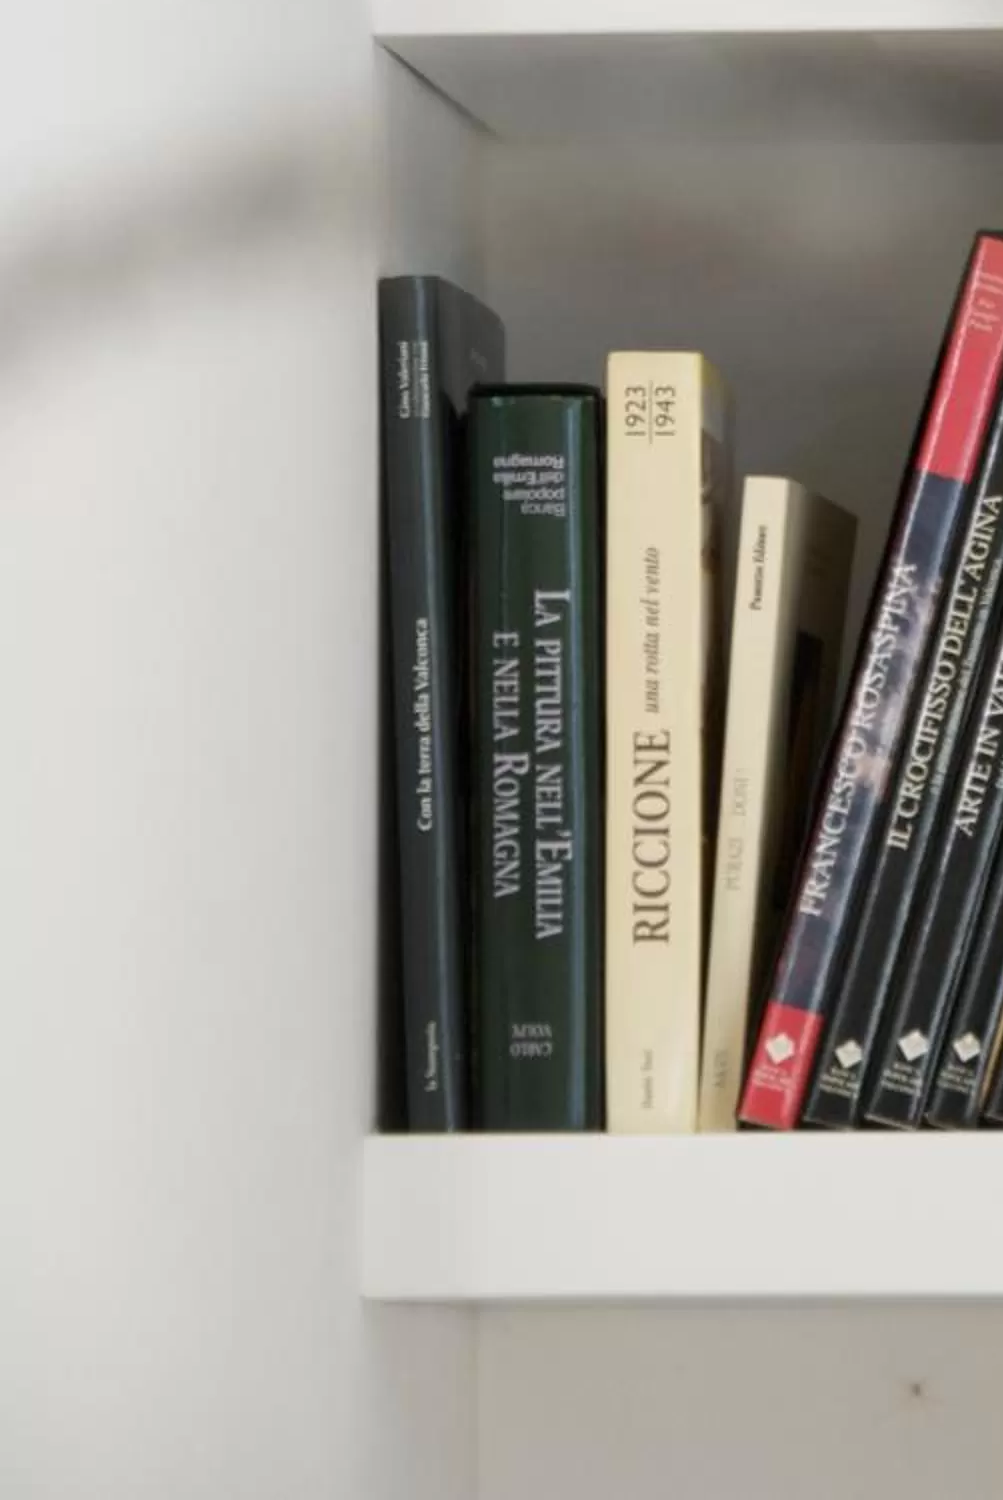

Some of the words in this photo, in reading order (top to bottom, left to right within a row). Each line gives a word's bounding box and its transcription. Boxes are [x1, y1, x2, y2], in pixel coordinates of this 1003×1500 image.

[625, 386, 647, 437] 1923
[655, 386, 676, 437] 1943
[521, 501, 565, 517] Banca
[642, 547, 660, 593] vento
[946, 494, 1003, 658] DELL'AGINA
[533, 590, 571, 627] LA
[639, 597, 660, 627] nel
[411, 618, 431, 689] Valconca
[492, 632, 520, 648] E
[642, 632, 660, 674] rotta
[413, 693, 431, 731] della
[493, 657, 520, 742] NELLA
[534, 639, 563, 754] PITTURA
[644, 679, 660, 713] una
[416, 736, 431, 773] terra
[800, 733, 866, 916] FRANCESCO
[856, 563, 918, 731] ROSASPINA
[898, 660, 960, 811] CROCIFISSO
[415, 778, 432, 792] la
[954, 757, 992, 836] ARTE
[975, 721, 1001, 758] IN
[415, 797, 432, 830] Con
[493, 751, 530, 899] ROMAGNA
[632, 729, 672, 946] RICCIONE
[886, 818, 912, 850] IL
[535, 764, 573, 940] NELL'EMILIA
